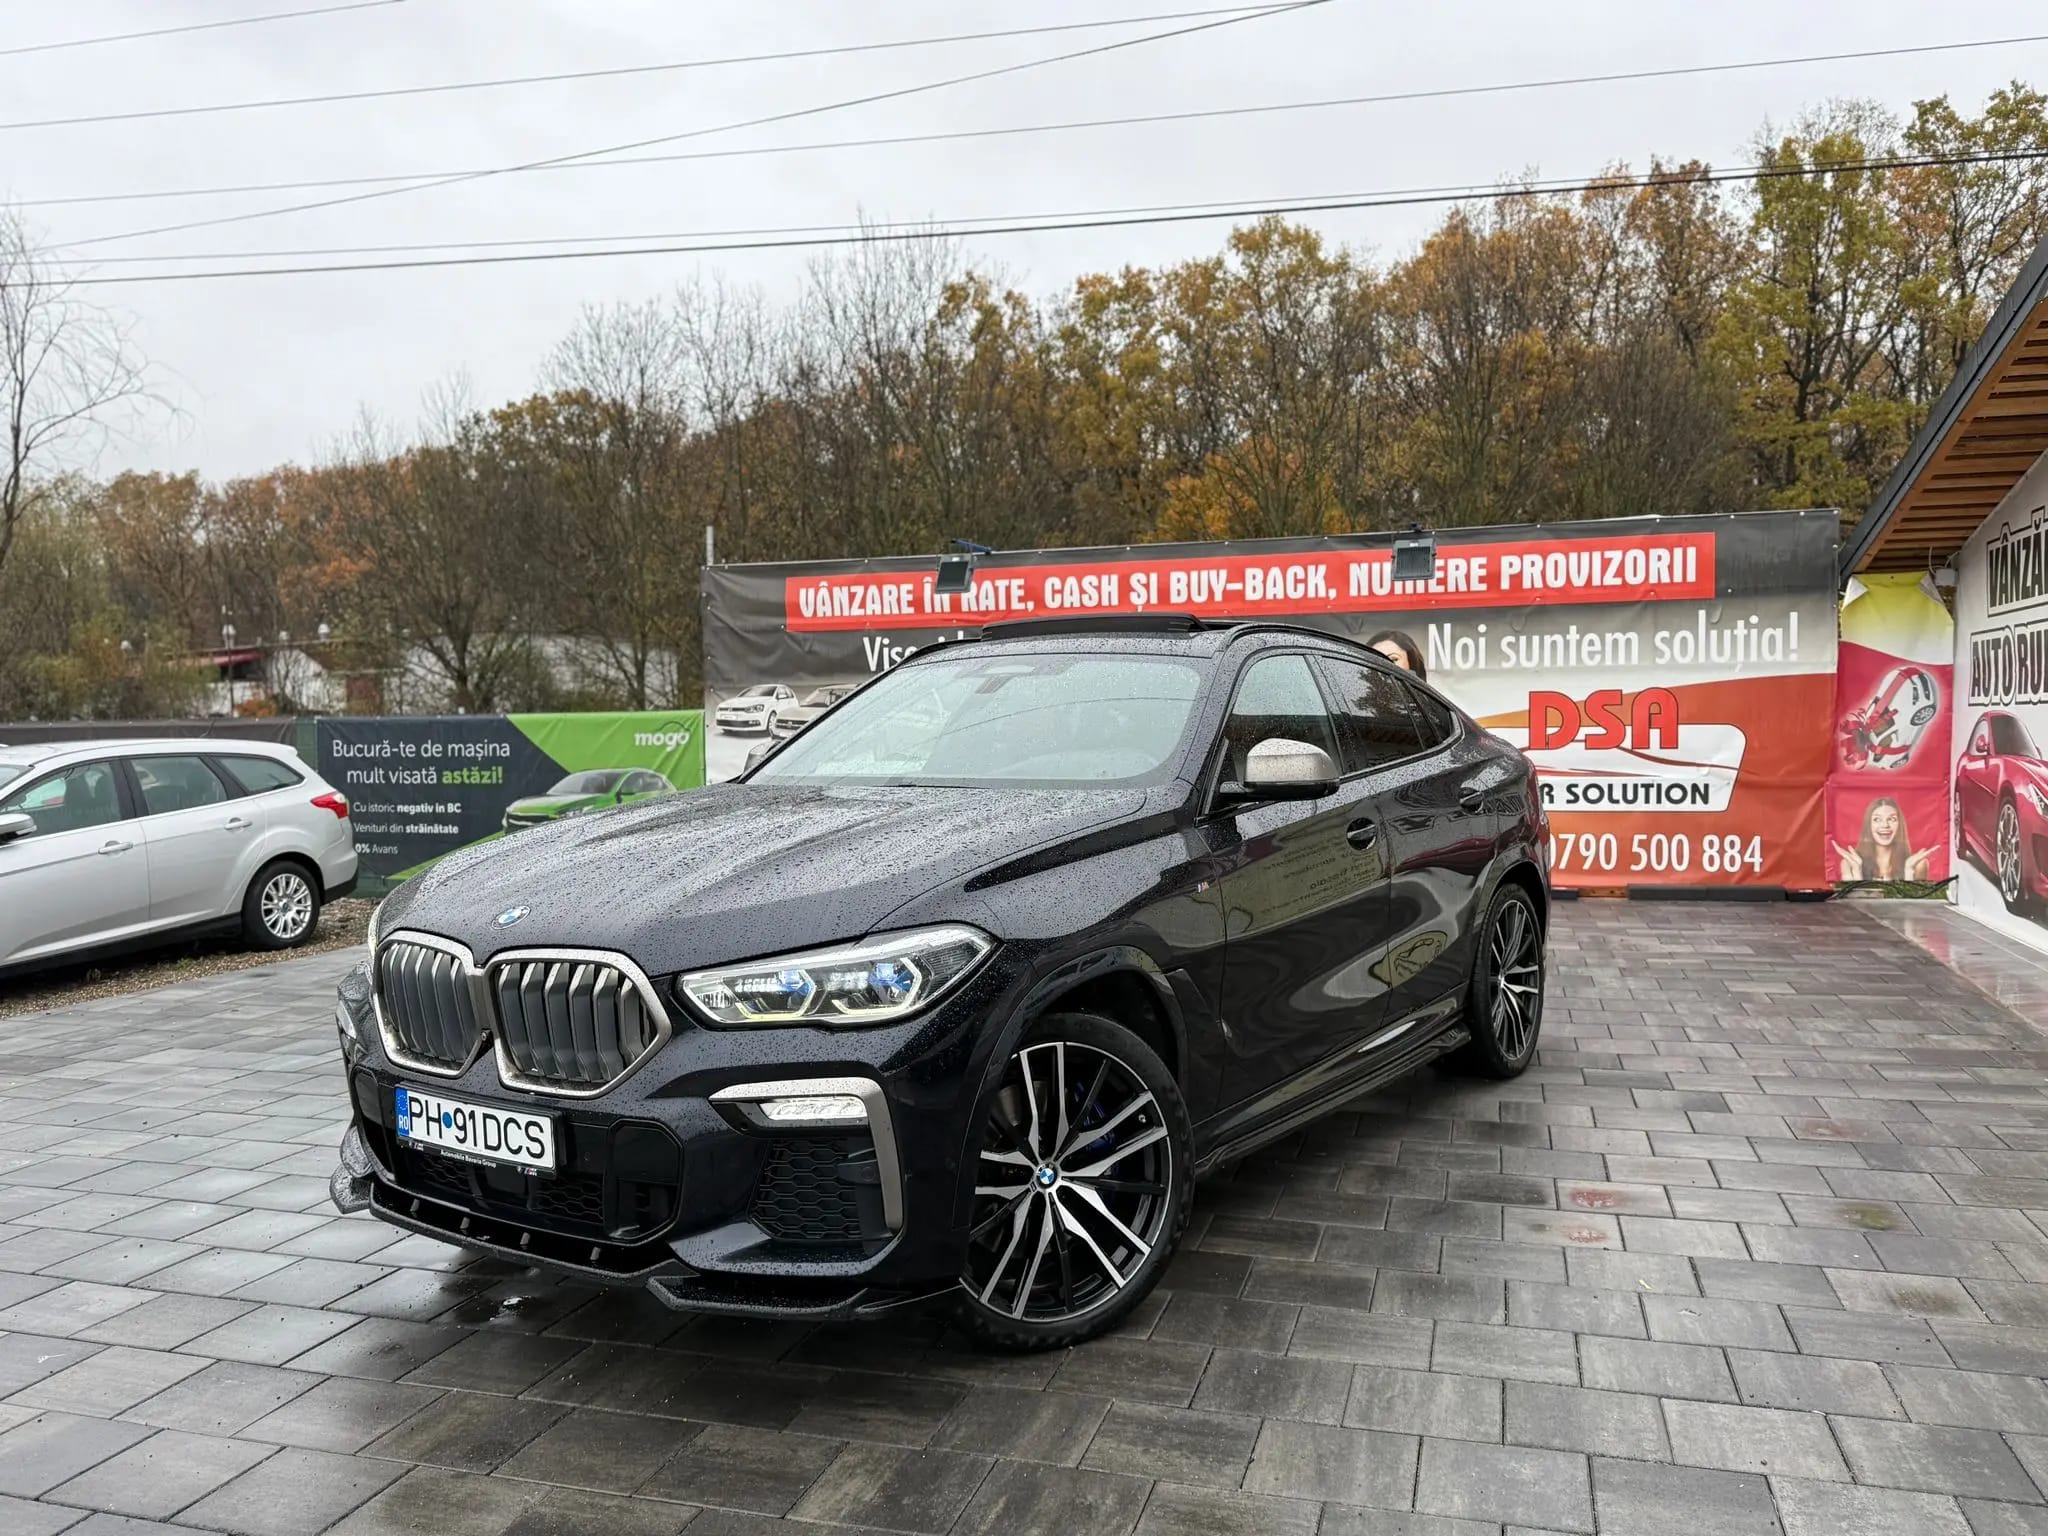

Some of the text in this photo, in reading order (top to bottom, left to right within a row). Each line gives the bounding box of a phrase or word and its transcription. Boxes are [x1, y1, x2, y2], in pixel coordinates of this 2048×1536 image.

[1989, 517, 2048, 608] VÂNZĂ
[799, 581, 914, 618] VÂNZARE
[961, 578, 1035, 613] RATE,
[1044, 574, 1120, 609] CASH
[1129, 572, 1159, 612] ȘI
[1170, 564, 1337, 605] BUY-BACK,
[1500, 547, 1697, 591] PROVIZORII
[1427, 609, 1799, 673] Noi suntem soluția!
[1528, 687, 1679, 750] DSA
[332, 739, 510, 761] Bucură-te de mașina
[634, 731, 691, 752] mogo
[347, 766, 503, 785] mult visată astăzi!
[1566, 783, 1710, 805] SOLUTION
[353, 802, 367, 813] Cu
[368, 802, 395, 813] istoric
[397, 803, 434, 815] negativ
[447, 802, 462, 813] BC
[353, 823, 388, 833] Venituri
[389, 822, 404, 833] din
[372, 844, 398, 855] Avans
[1630, 833, 1690, 872] 500
[1702, 834, 1763, 873] 884
